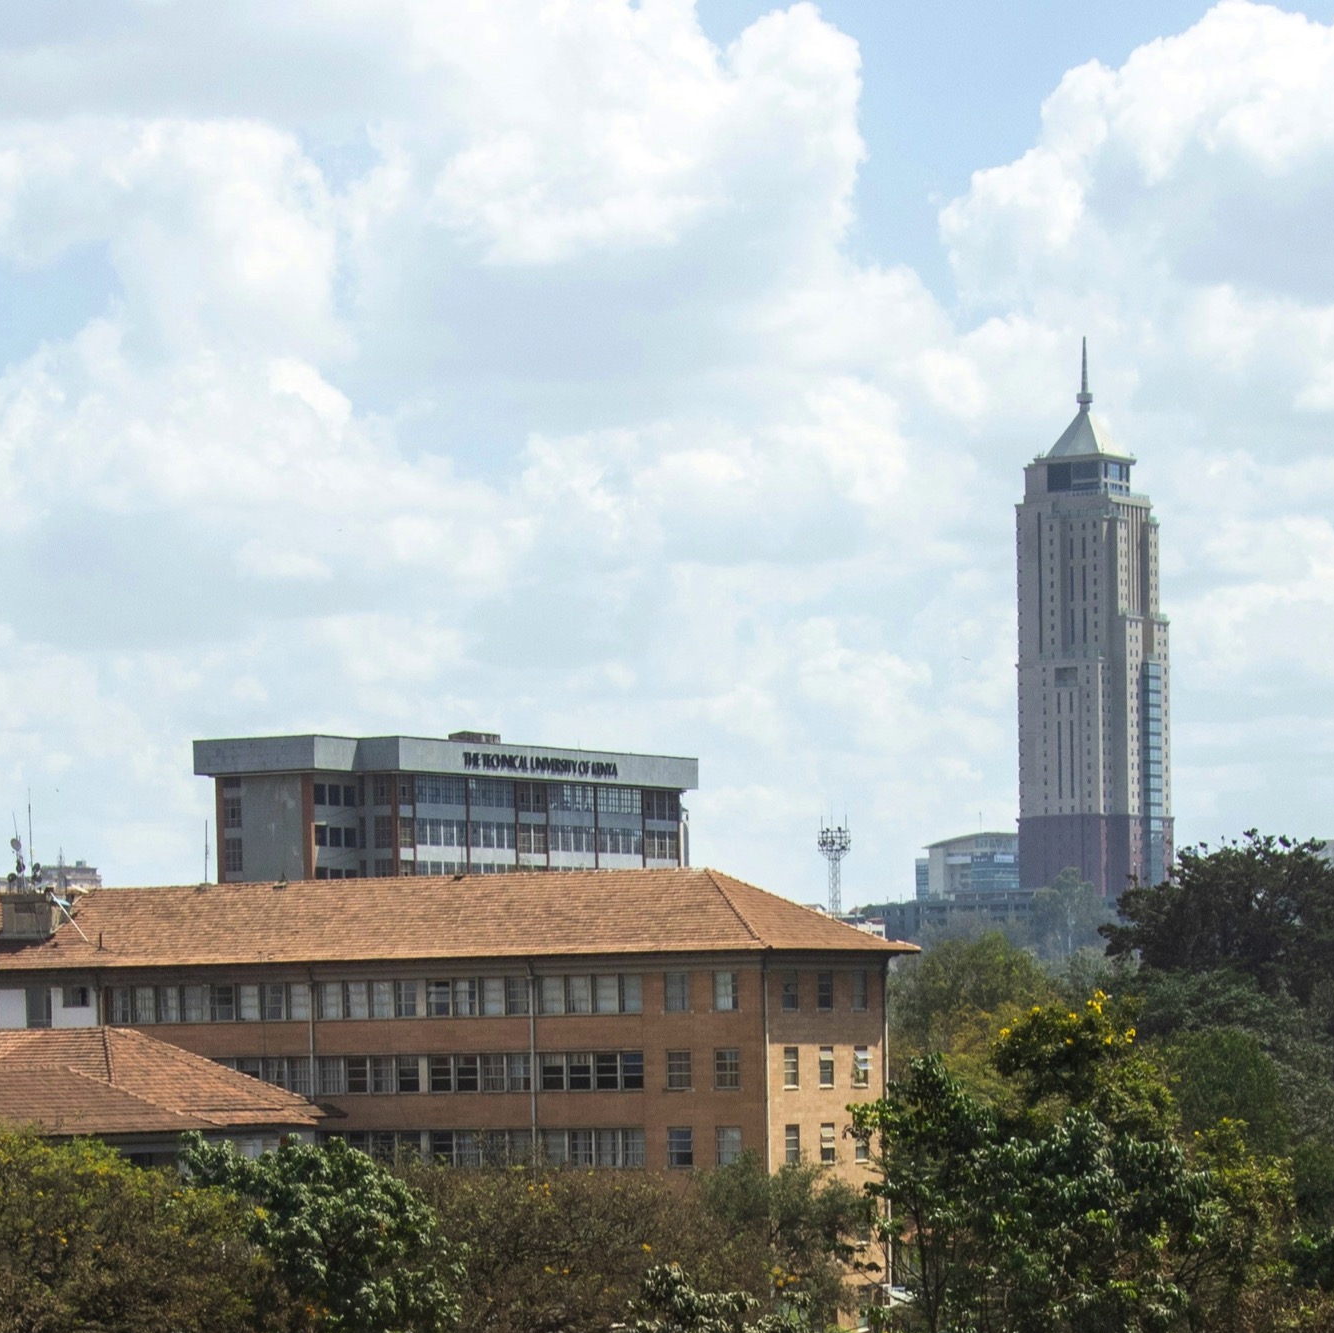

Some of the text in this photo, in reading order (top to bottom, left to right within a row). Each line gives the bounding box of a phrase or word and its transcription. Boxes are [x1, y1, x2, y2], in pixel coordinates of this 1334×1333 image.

[463, 752, 618, 778] THE TECHNICAL UNIVERSITY OF KENYA
